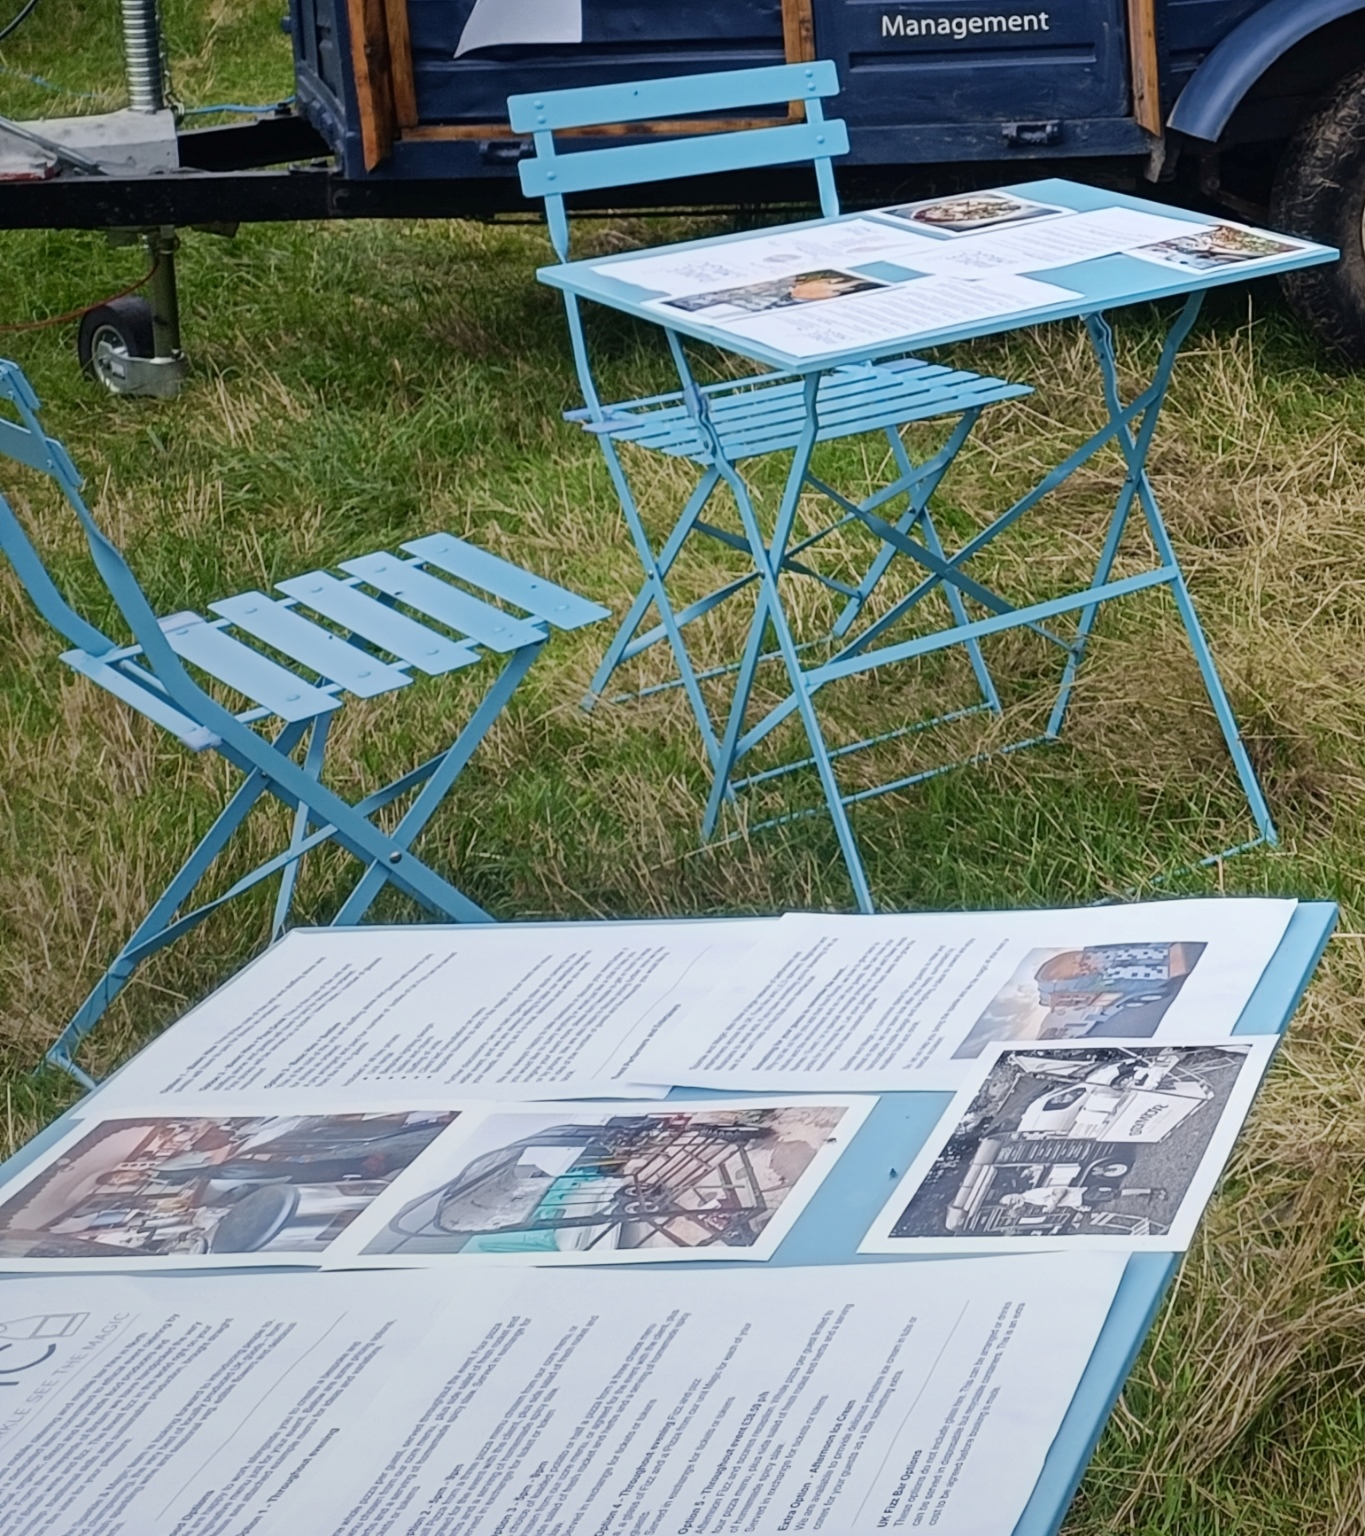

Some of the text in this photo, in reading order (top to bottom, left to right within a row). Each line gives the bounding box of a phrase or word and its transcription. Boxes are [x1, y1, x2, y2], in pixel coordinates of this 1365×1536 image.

[882, 11, 1050, 40] Management
[26, 1379, 59, 1404] SEE
[51, 1353, 89, 1376] THE
[81, 1312, 130, 1351] MAGIC
[266, 1458, 314, 1501] Throughout
[308, 1427, 342, 1456] evening
[593, 1510, 620, 1536] Option
[617, 1451, 658, 1496] Throughout
[647, 1421, 676, 1449] evening
[676, 1508, 702, 1534] Option
[699, 1448, 739, 1494] Throughout
[728, 1426, 748, 1446] event
[776, 1399, 856, 1531] Extra Option Afternoon Ice Cream
[876, 1449, 925, 1527] UK Fizz Bar Options
[892, 1503, 912, 1526] These
[905, 1475, 927, 1501] options
[911, 1512, 925, 1526] can
[926, 1509, 942, 1525] cost
